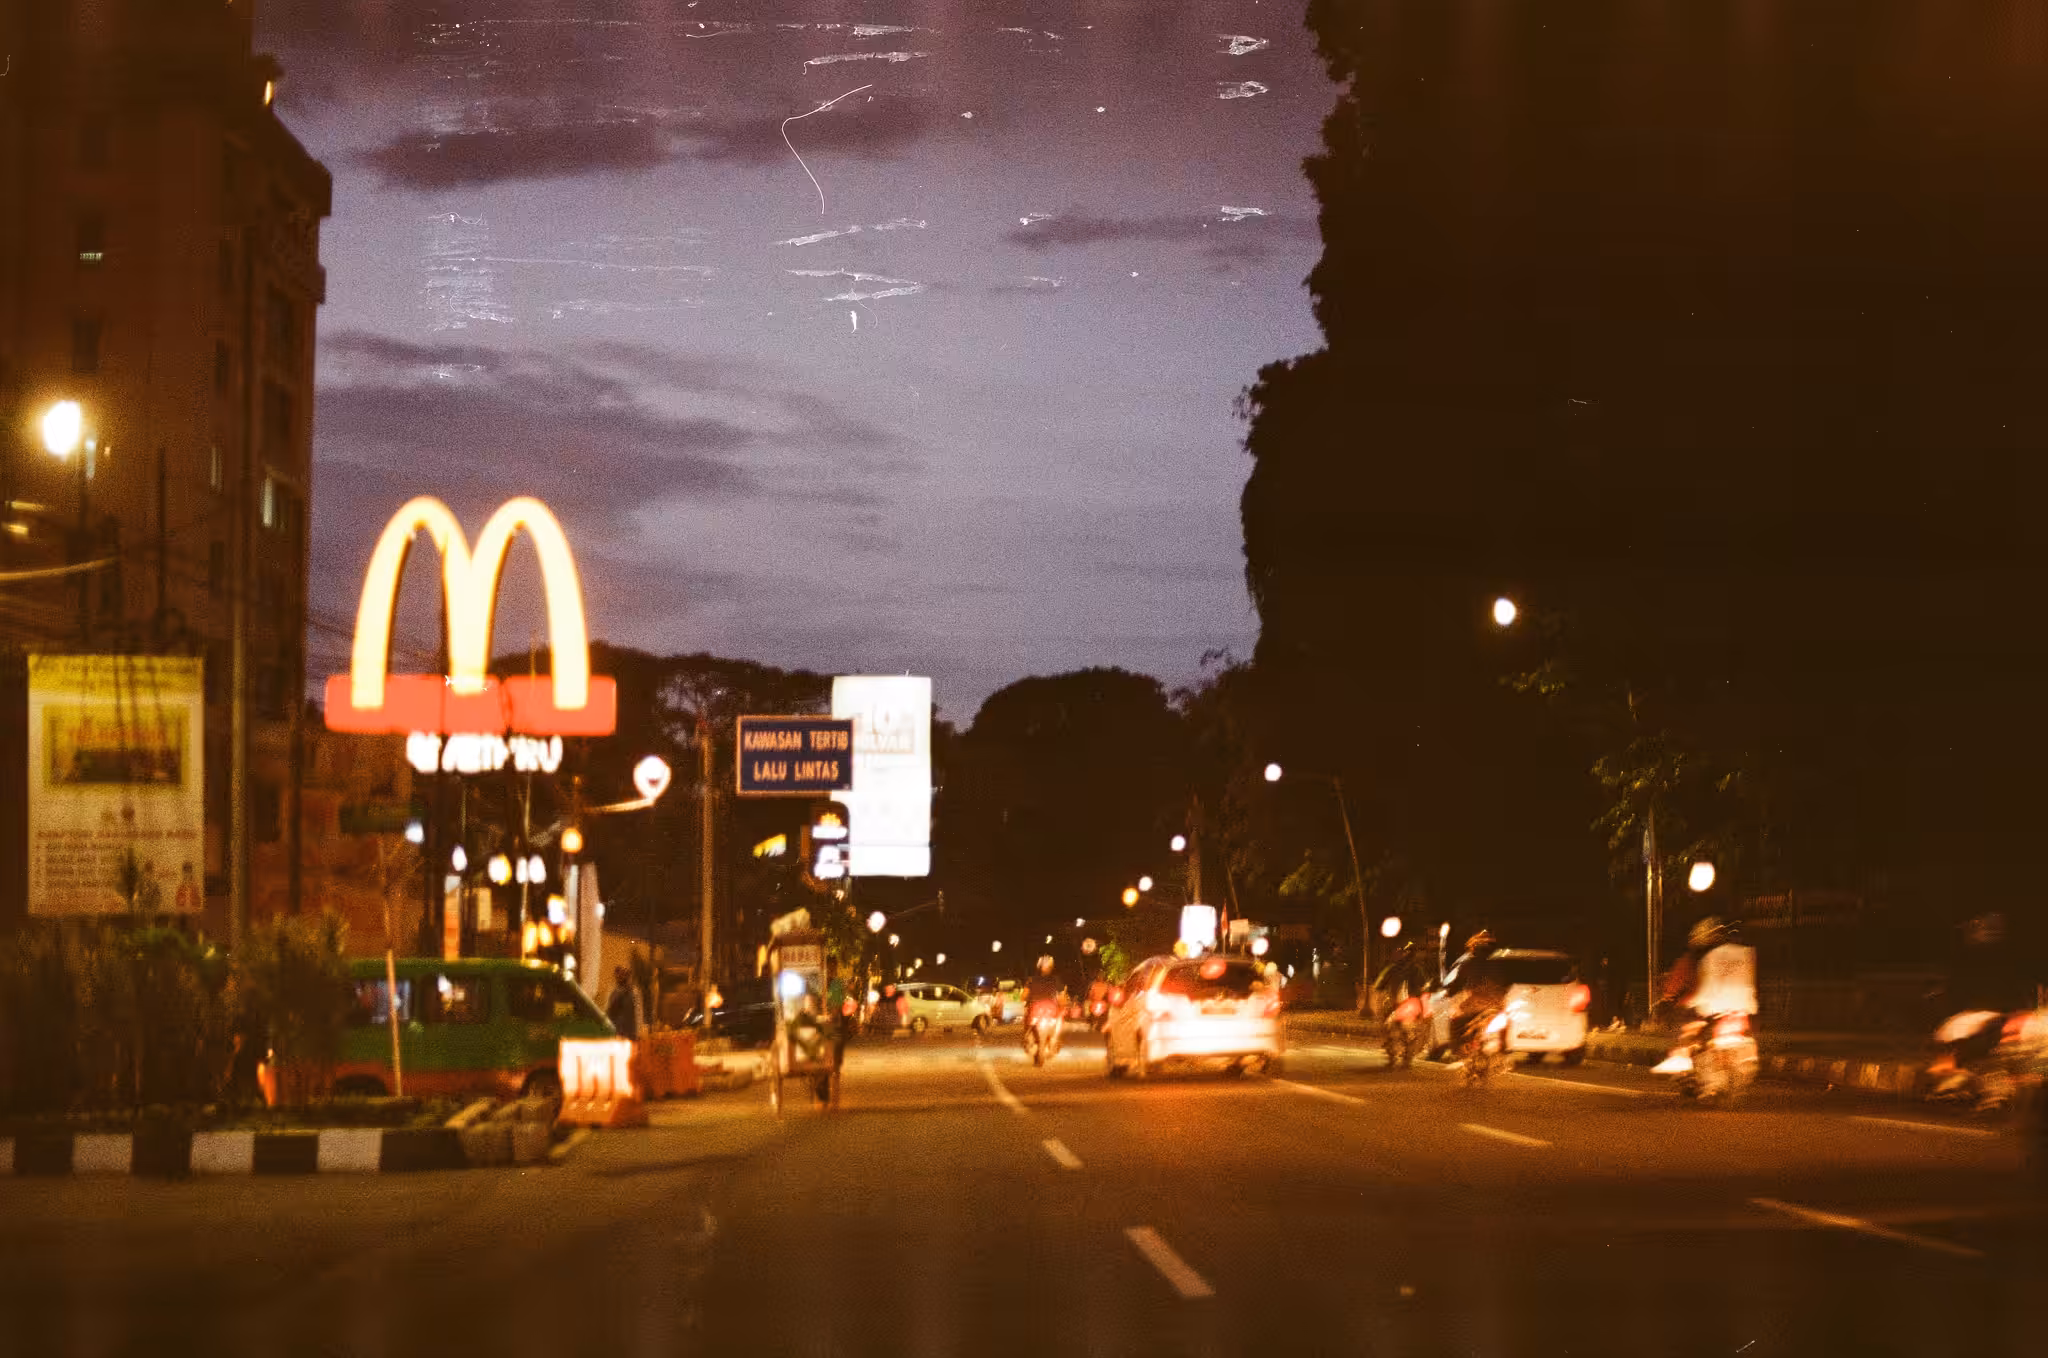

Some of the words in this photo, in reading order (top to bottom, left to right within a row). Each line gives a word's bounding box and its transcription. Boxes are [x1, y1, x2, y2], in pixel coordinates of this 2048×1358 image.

[744, 731, 802, 752] KAWASAN
[810, 731, 848, 751] TERTIB
[754, 761, 787, 782] LALU
[794, 761, 838, 781] LINTAS
